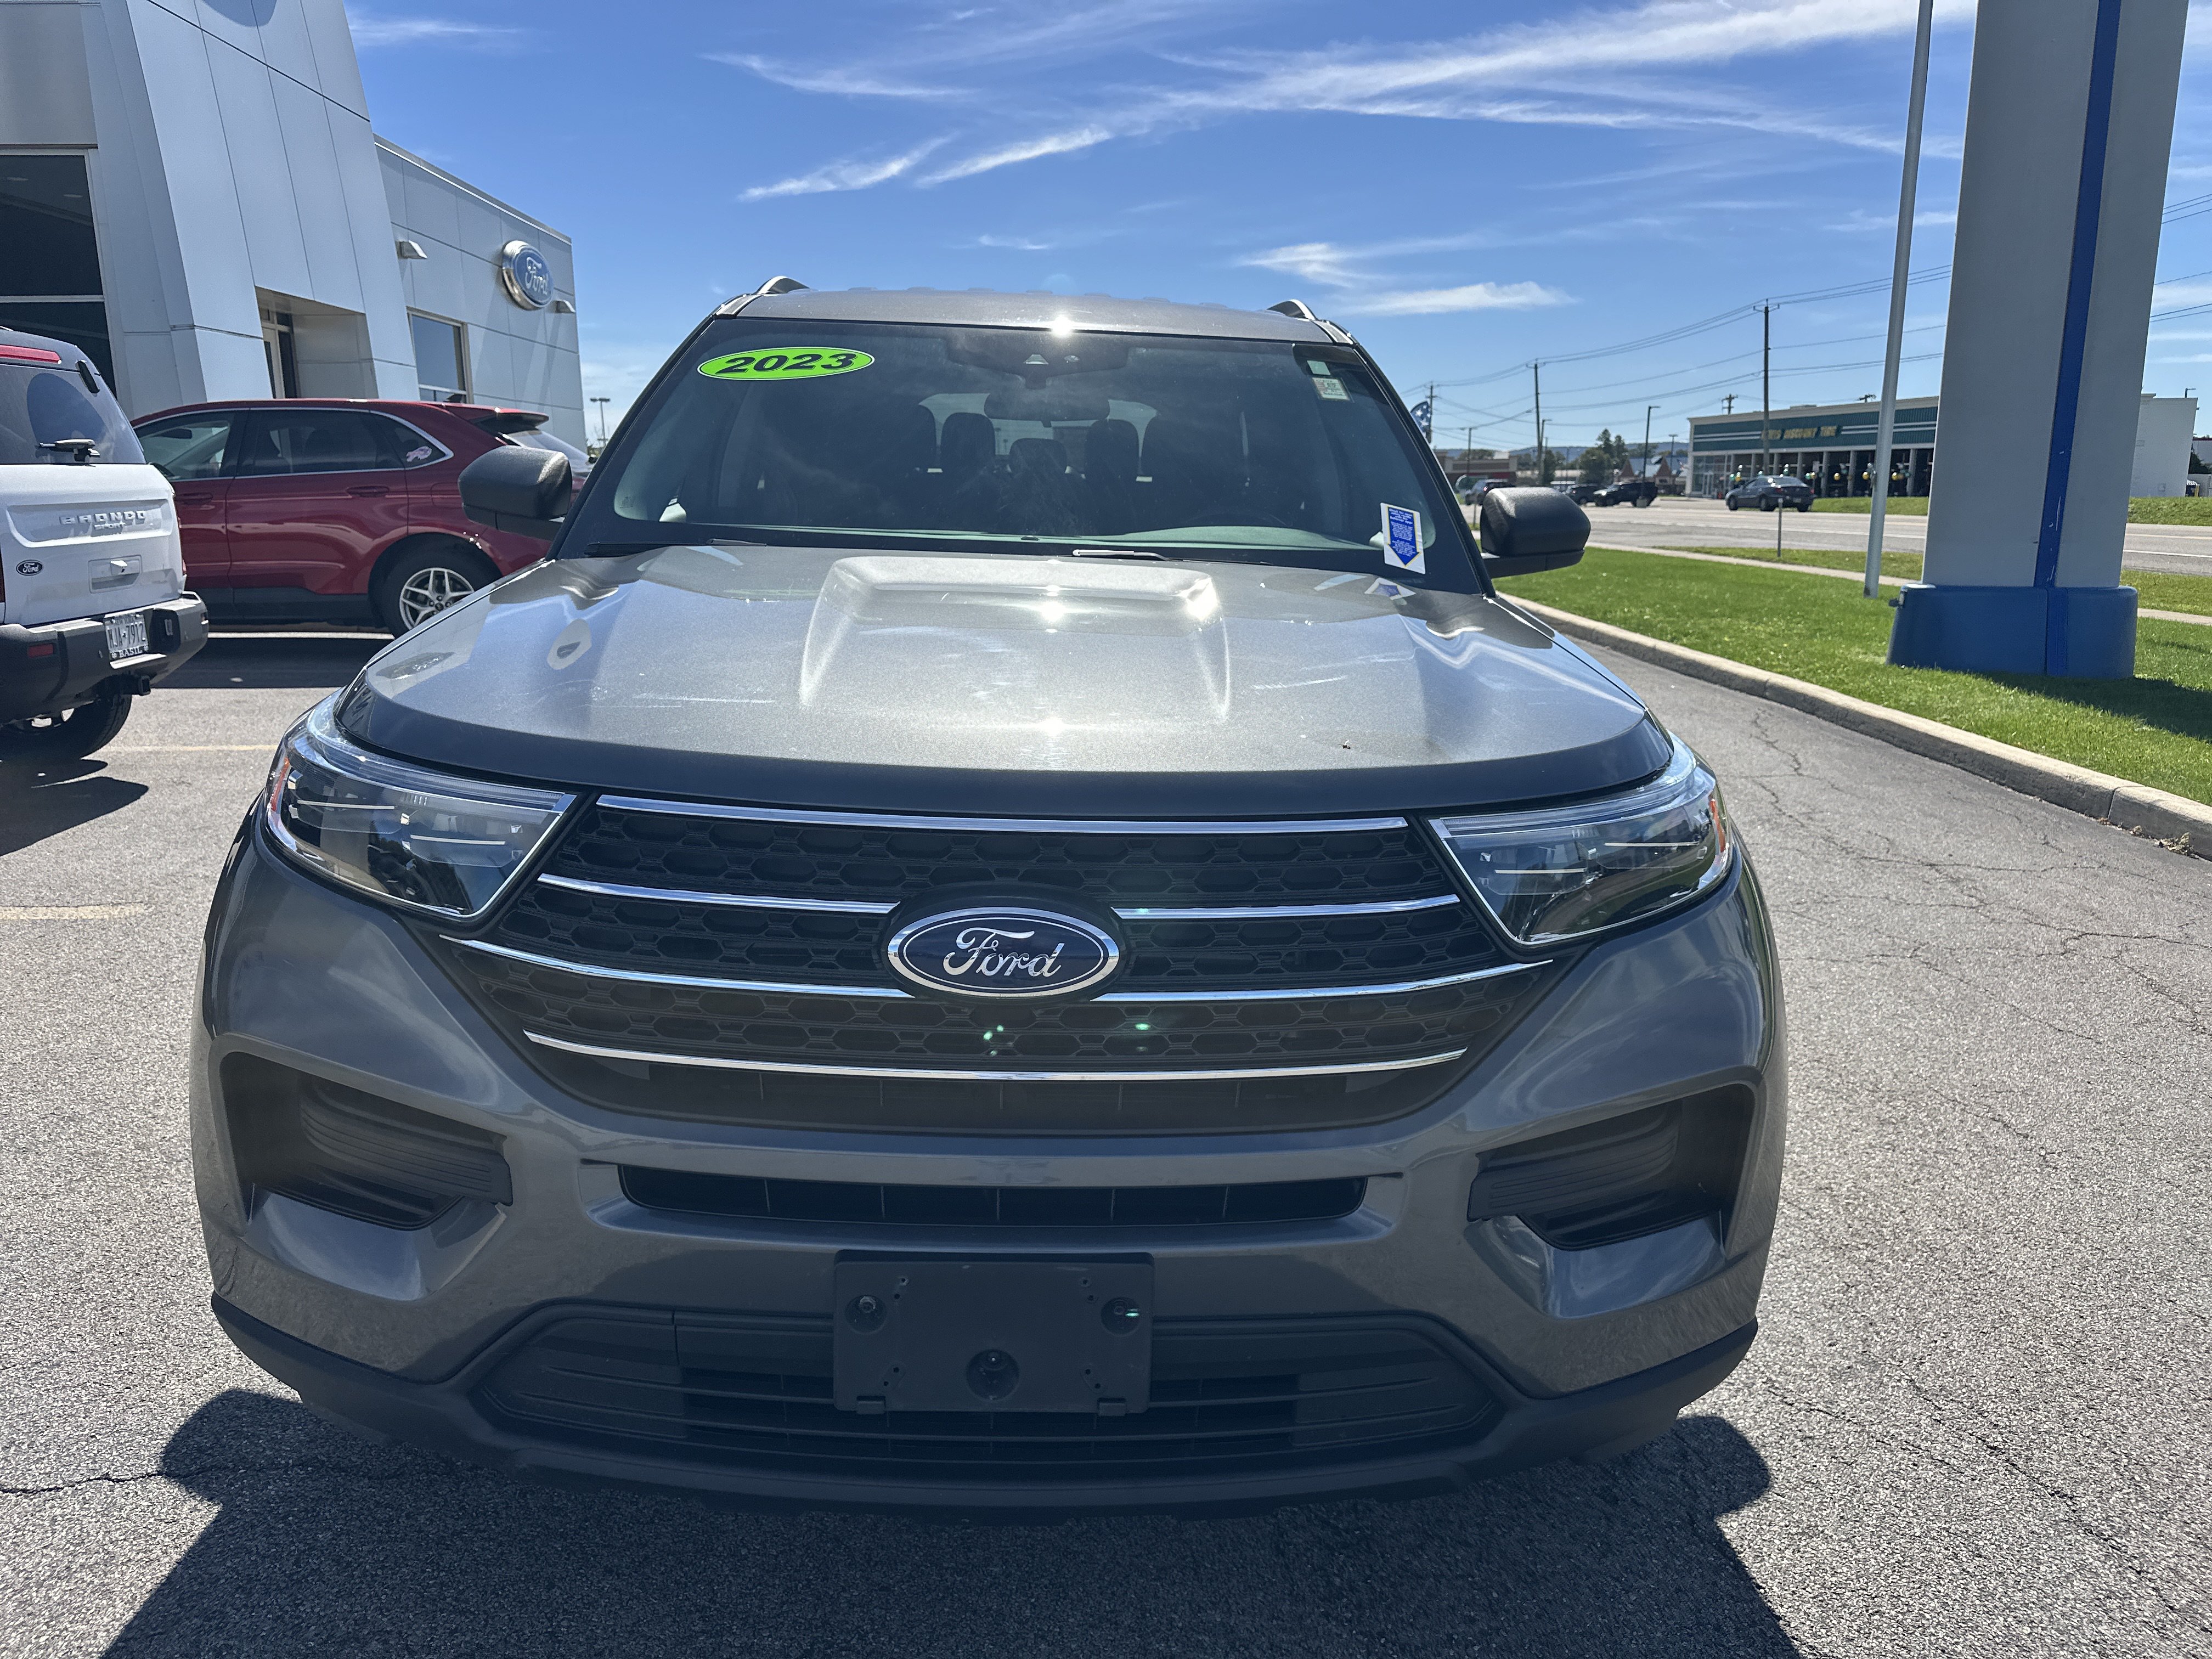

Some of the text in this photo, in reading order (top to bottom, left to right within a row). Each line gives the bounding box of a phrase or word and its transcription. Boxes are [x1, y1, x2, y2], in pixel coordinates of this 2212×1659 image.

[525, 256, 549, 296] Ford
[715, 353, 858, 374] 2023
[59, 511, 146, 525] BRONCO
[94, 522, 125, 531] SPORT
[22, 562, 39, 573] Ford
[119, 646, 143, 658] BASIL
[943, 927, 1064, 977] Ford
